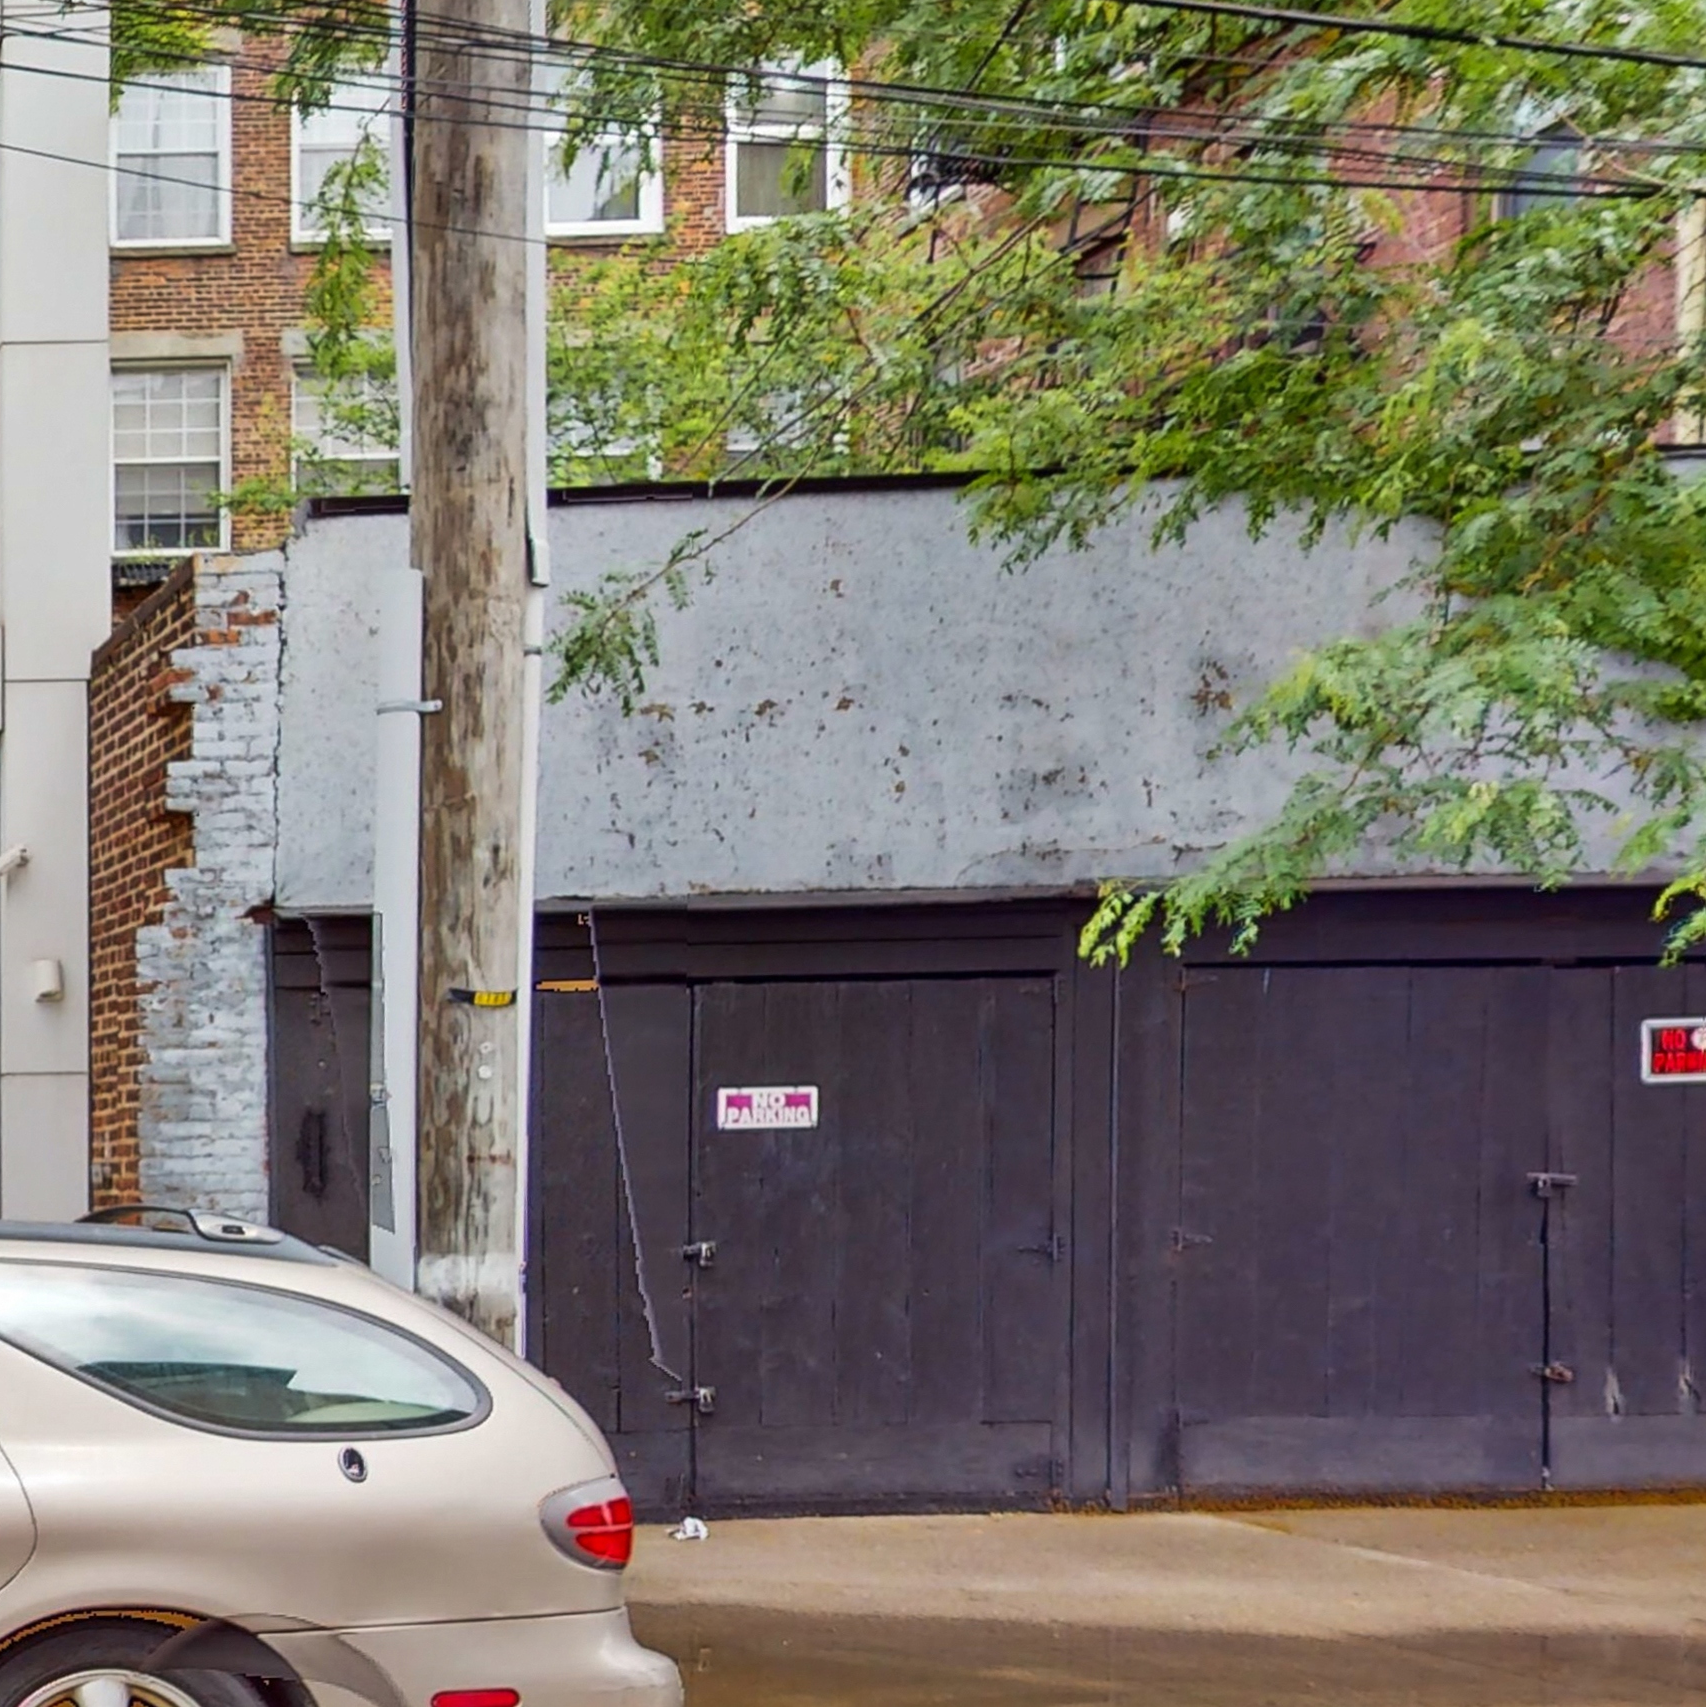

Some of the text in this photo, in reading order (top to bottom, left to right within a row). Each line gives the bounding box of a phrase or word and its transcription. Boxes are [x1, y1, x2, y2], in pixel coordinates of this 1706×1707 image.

[1661, 1028, 1686, 1050] NO
[1652, 1051, 1706, 1073] PARKI
[751, 1092, 787, 1109] NO
[725, 1105, 811, 1124] PARKING
